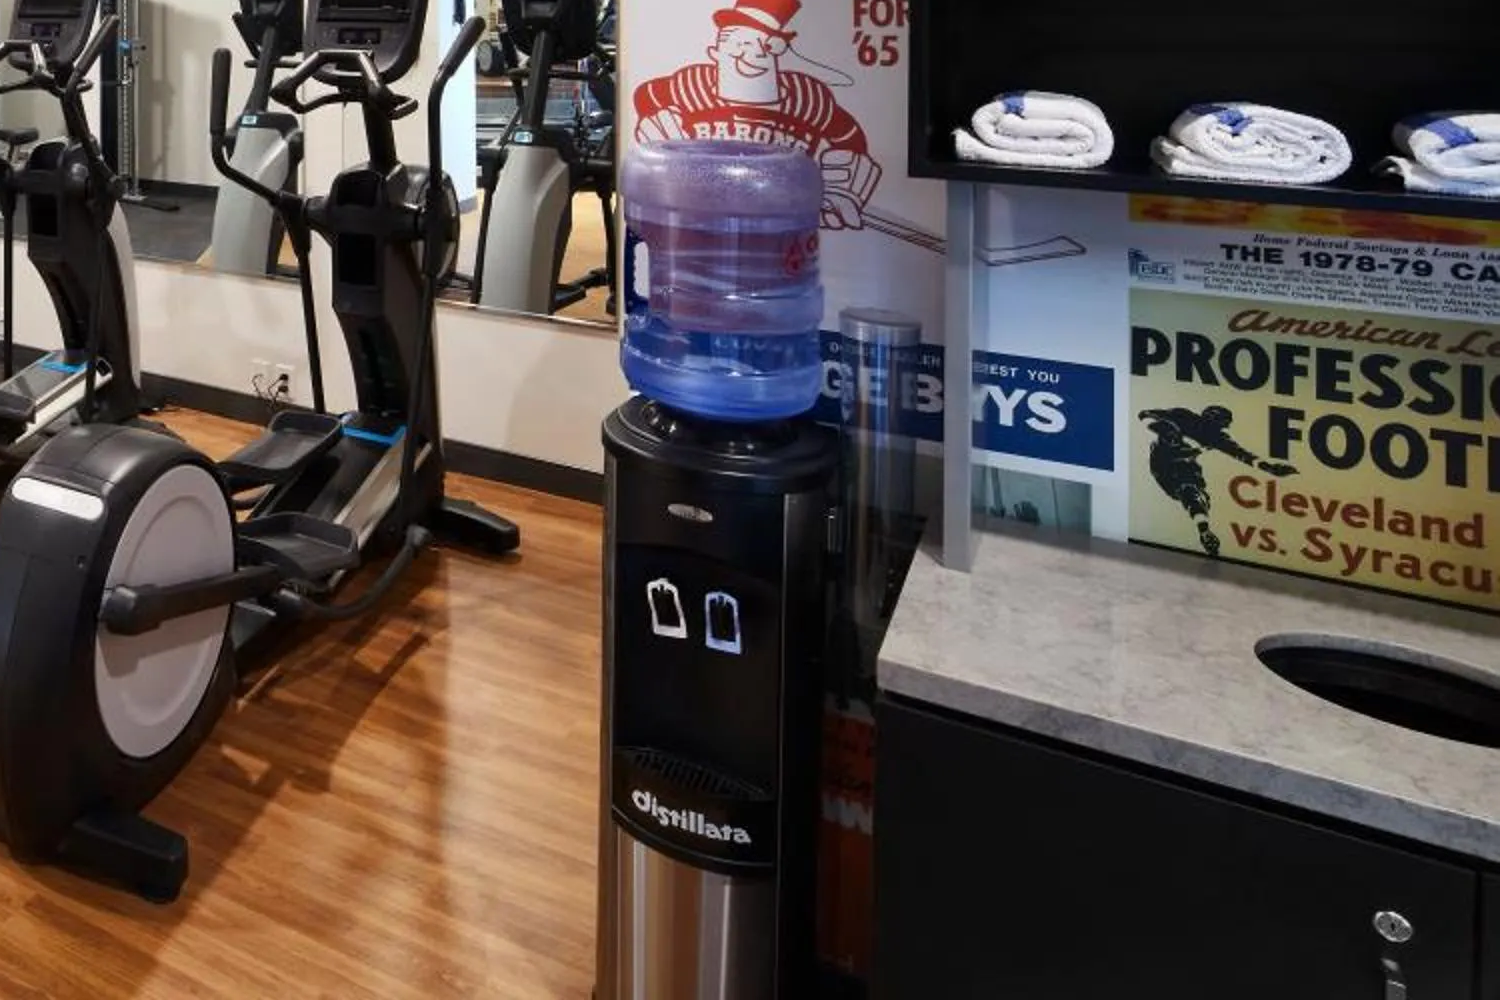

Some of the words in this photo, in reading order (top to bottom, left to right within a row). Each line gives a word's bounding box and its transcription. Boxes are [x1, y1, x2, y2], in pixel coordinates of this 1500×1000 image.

[1219, 243, 1285, 265] THE
[1298, 250, 1434, 278] 1978-79
[1026, 368, 1061, 385] YOU
[1130, 325, 1500, 422] PROFESSI
[1227, 474, 1486, 551] Cleveland
[1230, 522, 1288, 558] vs.
[1300, 527, 1500, 595] Syracu
[631, 789, 752, 845] distillata
